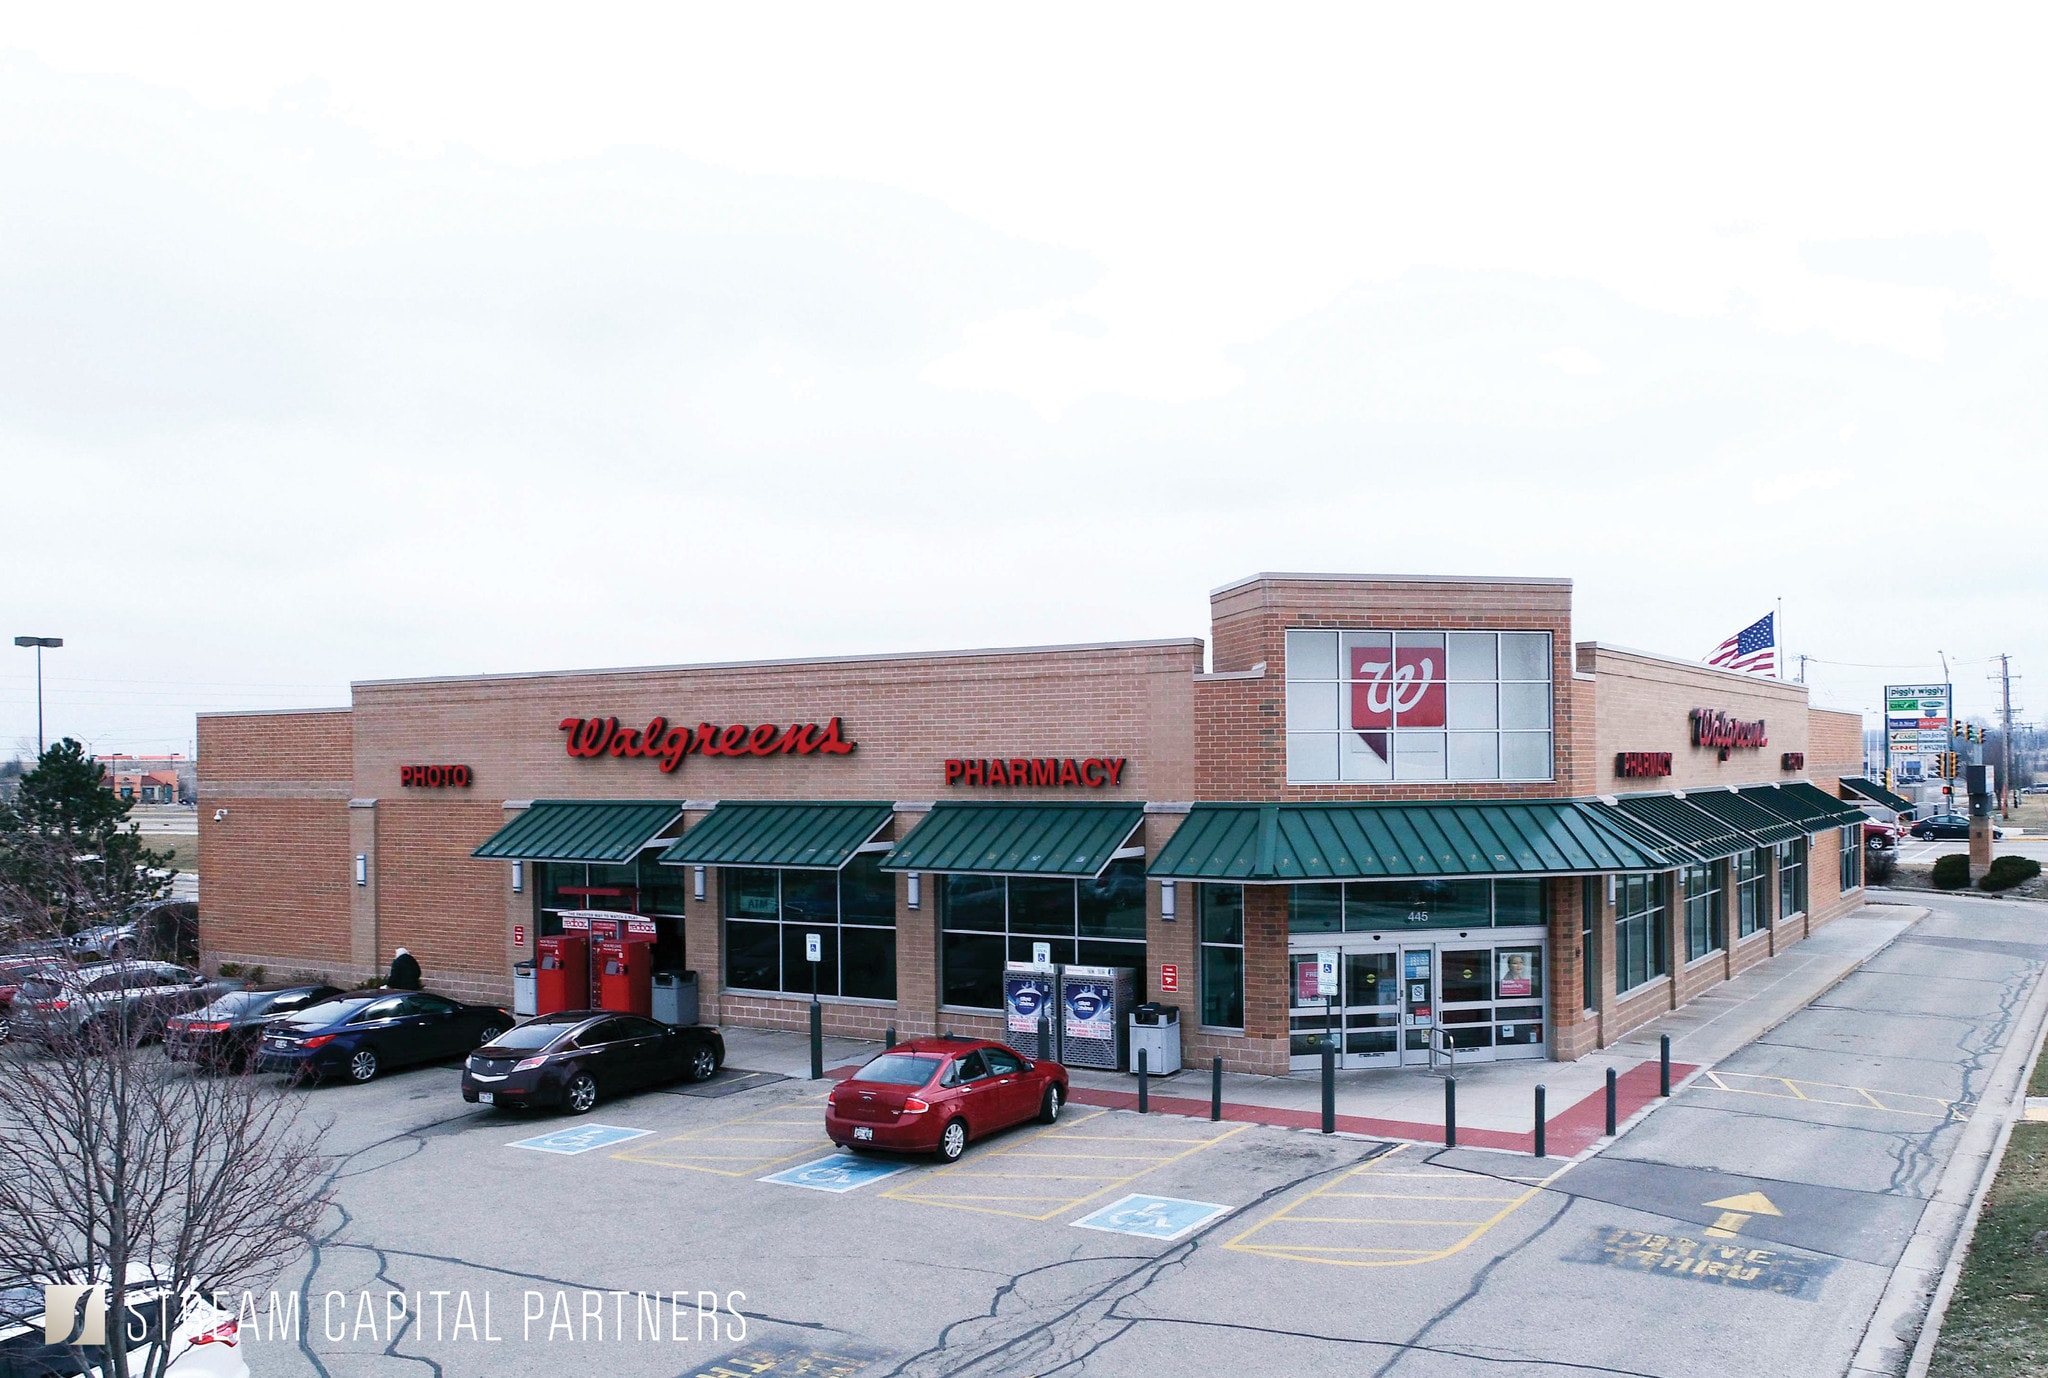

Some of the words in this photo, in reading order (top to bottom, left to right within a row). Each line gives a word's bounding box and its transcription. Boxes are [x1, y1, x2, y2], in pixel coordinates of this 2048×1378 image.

[559, 717, 857, 773] Walgreens
[401, 765, 472, 787] PHOTO
[943, 758, 1127, 787] PHARMACY
[1616, 752, 1673, 777] PHARMACY
[1407, 911, 1429, 922] 445
